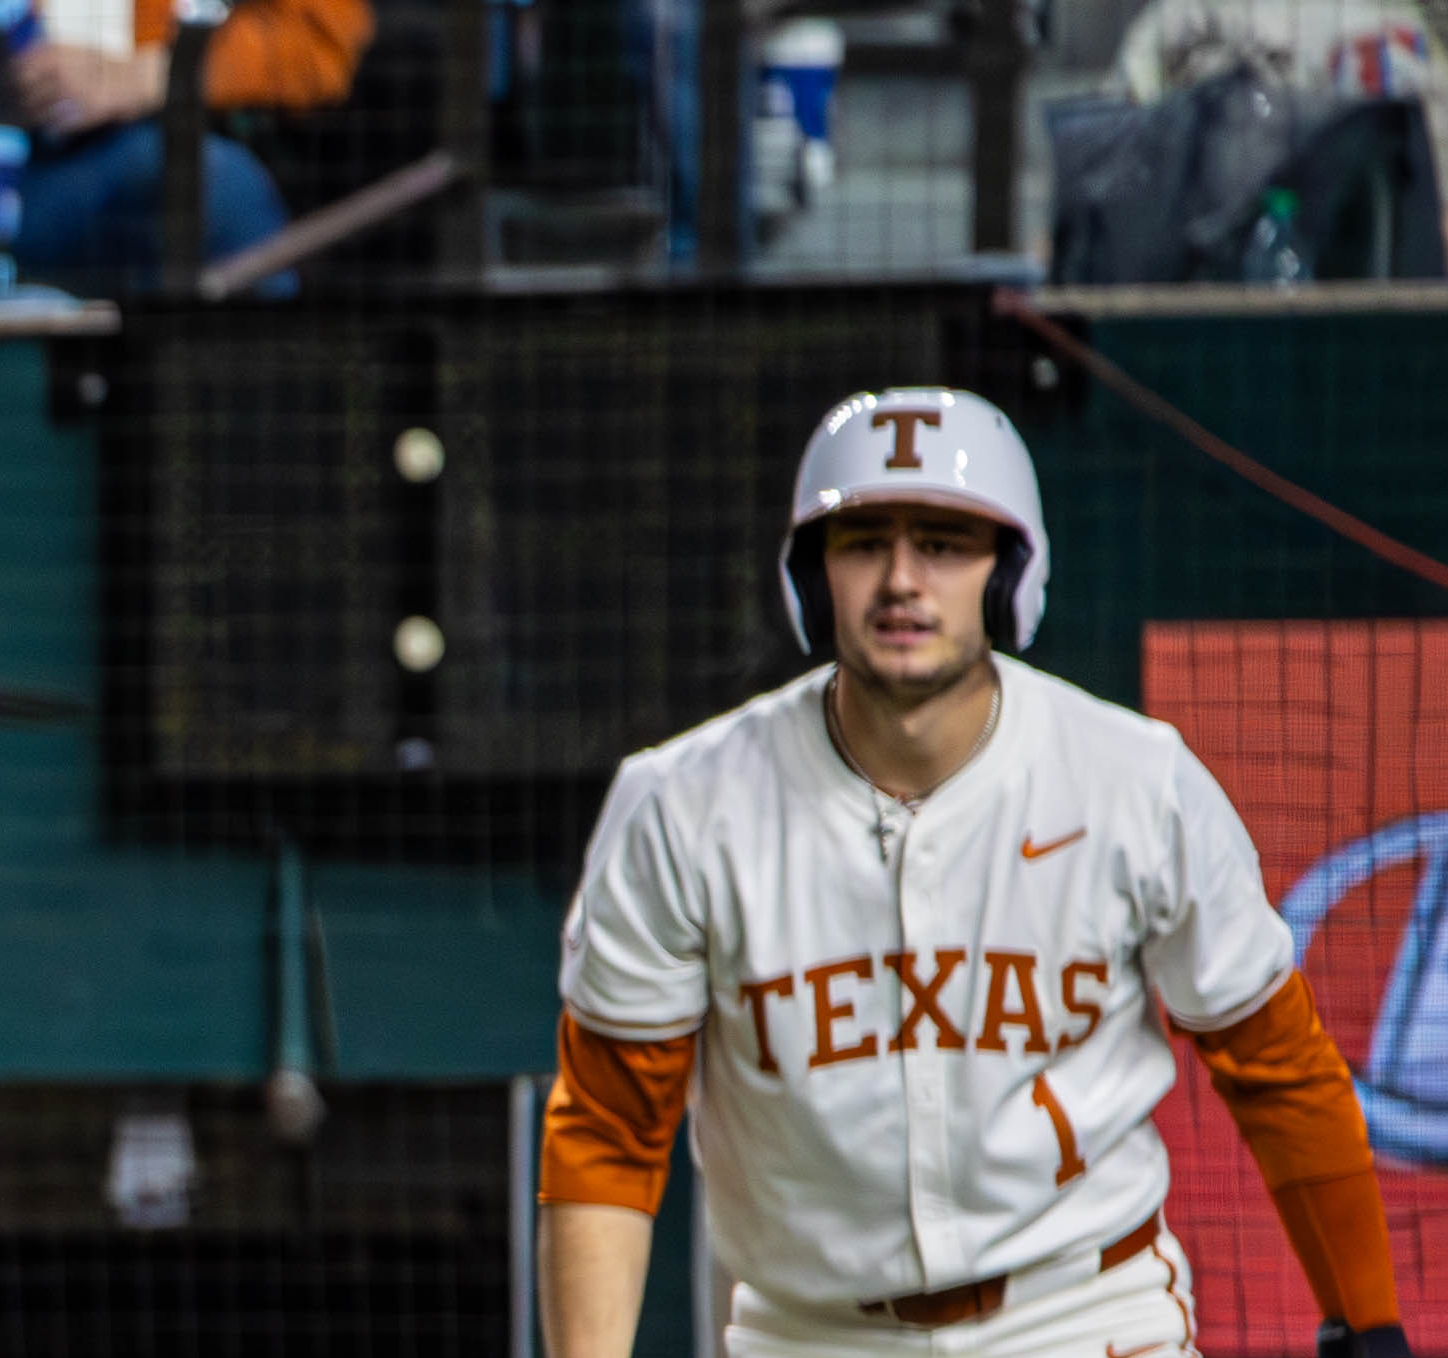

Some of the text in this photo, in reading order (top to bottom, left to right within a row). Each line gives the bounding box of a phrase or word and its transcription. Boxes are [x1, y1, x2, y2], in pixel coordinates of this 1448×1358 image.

[870, 409, 941, 471] T
[740, 946, 1109, 1073] TEXAS
[1032, 1071, 1086, 1188] 1
